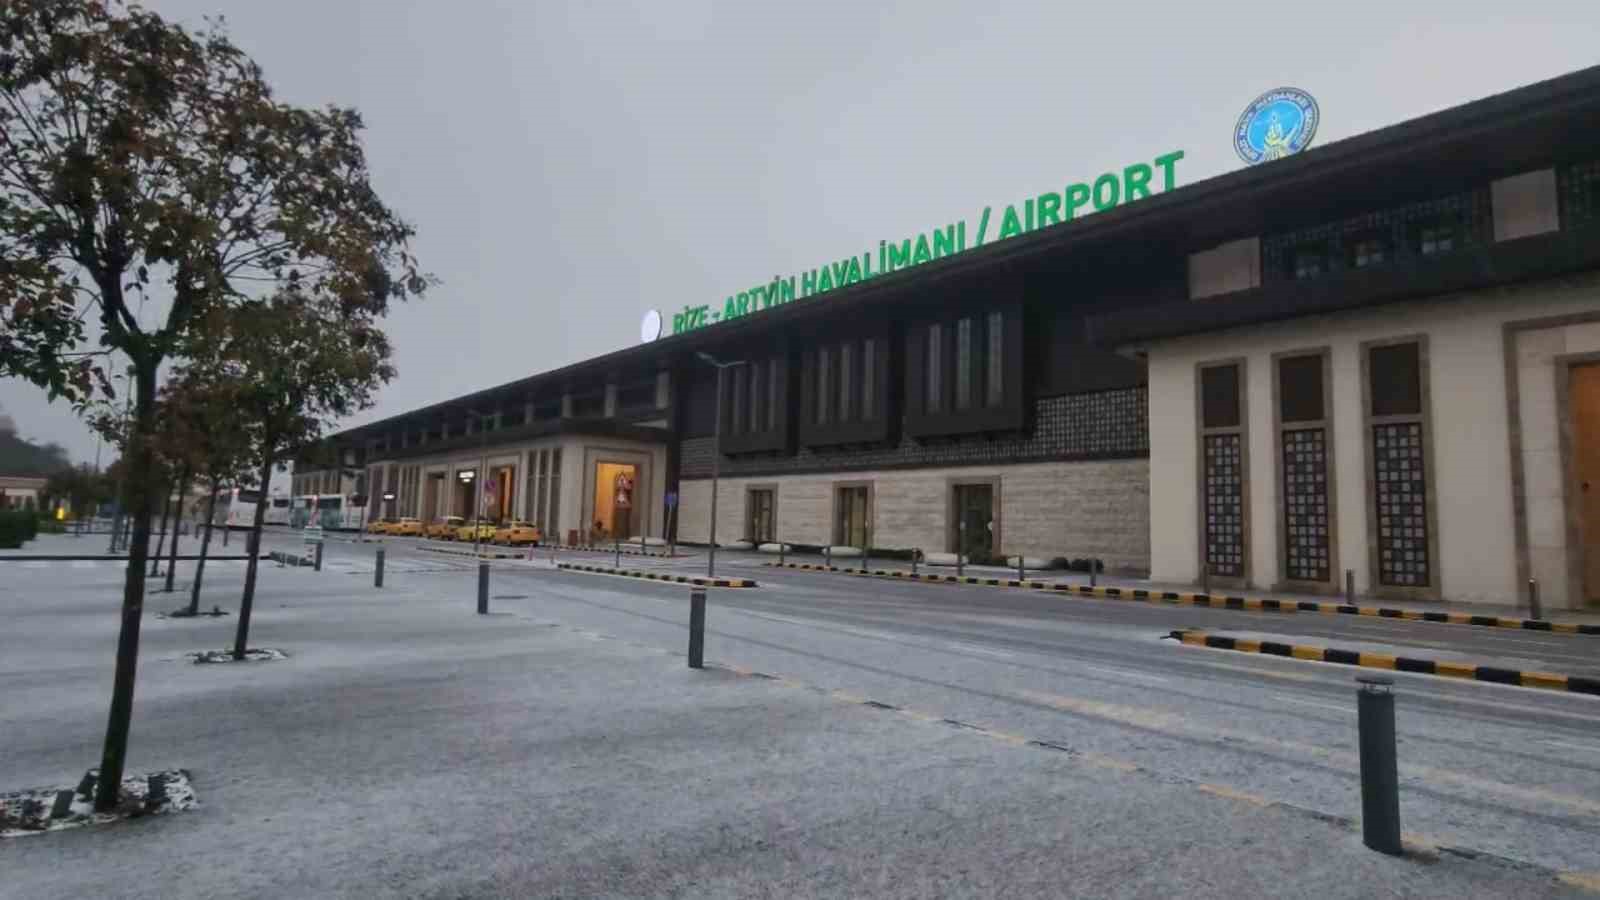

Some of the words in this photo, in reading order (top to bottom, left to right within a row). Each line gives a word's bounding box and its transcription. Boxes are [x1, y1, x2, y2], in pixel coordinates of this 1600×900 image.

[673, 305, 708, 334] RİZE
[724, 275, 796, 321] ARTVİN
[802, 221, 966, 297] HAVALİMANI
[975, 207, 991, 247] /
[999, 150, 1184, 240] AIRPORT
